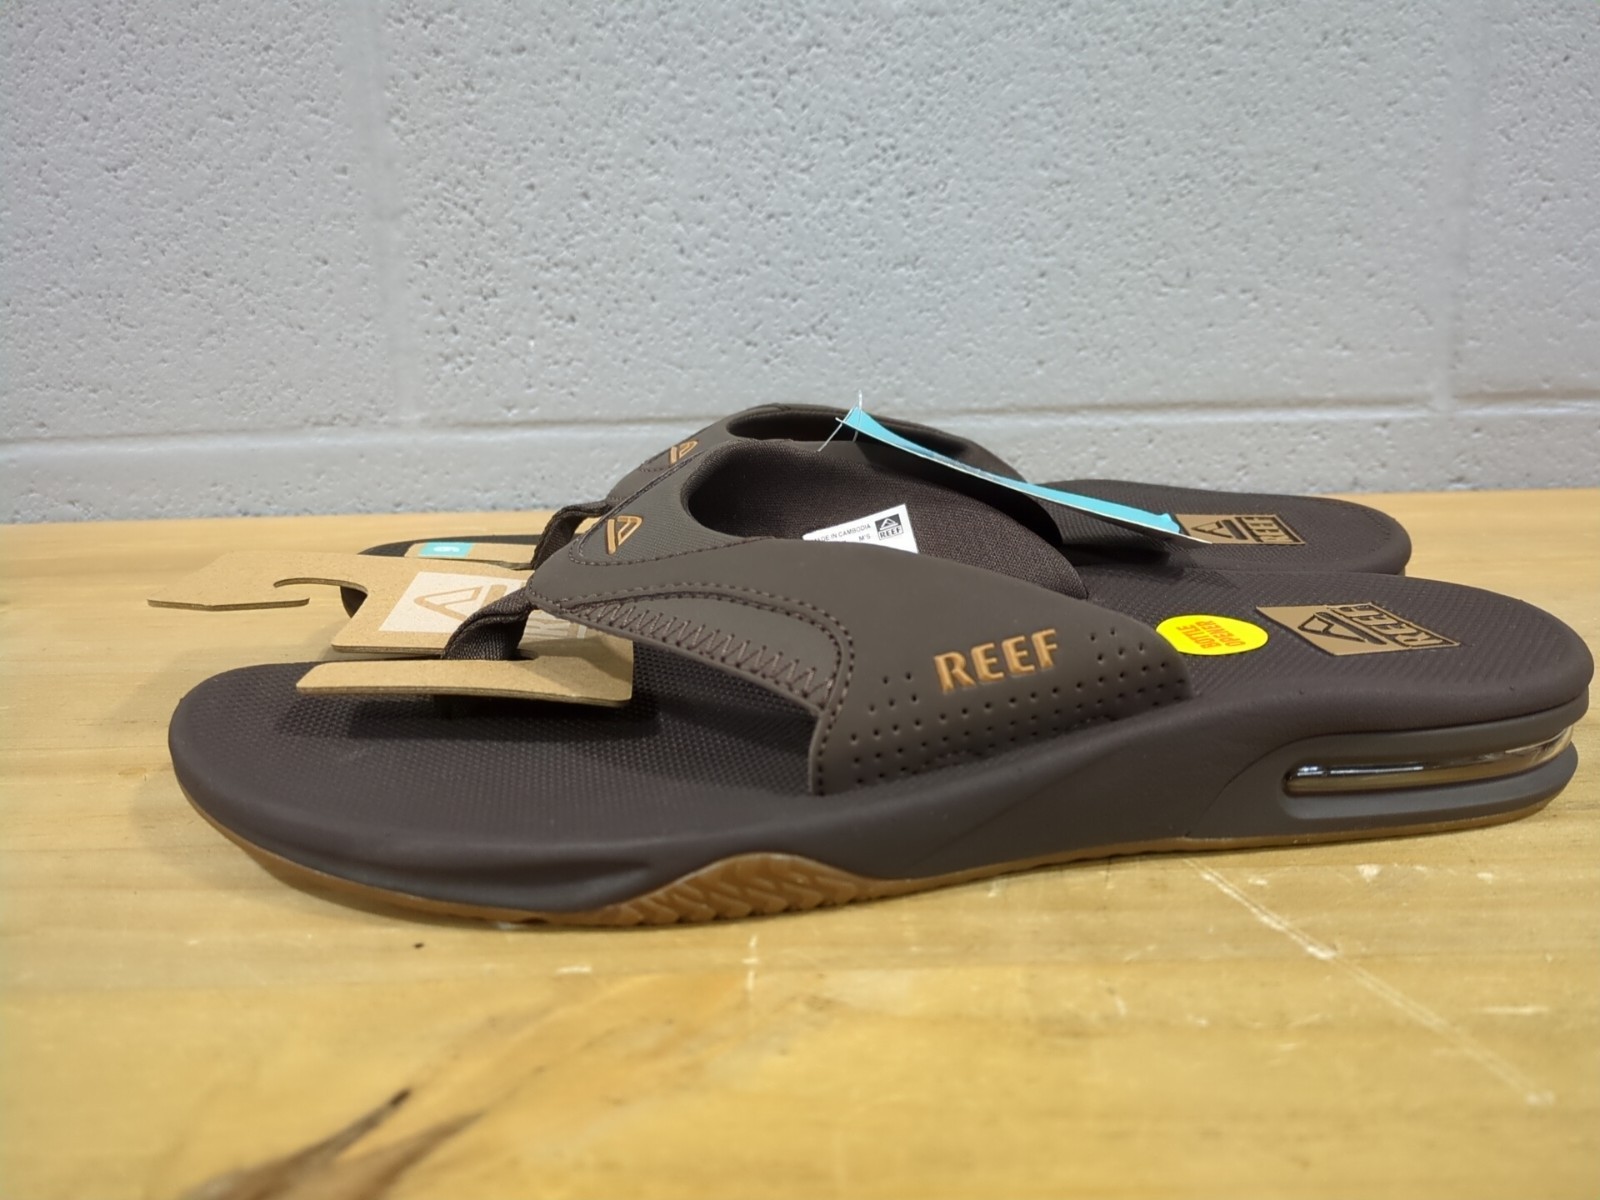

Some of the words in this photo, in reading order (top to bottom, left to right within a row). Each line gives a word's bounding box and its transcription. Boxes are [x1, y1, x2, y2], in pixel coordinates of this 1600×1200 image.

[838, 523, 872, 538] CAMBODIA
[879, 526, 902, 539] REEF
[1241, 516, 1294, 543] REEF
[1176, 624, 1222, 649] BOTTLE
[1195, 620, 1246, 647] OPENER
[1334, 604, 1443, 646] REEF
[932, 628, 1058, 694] REEF
